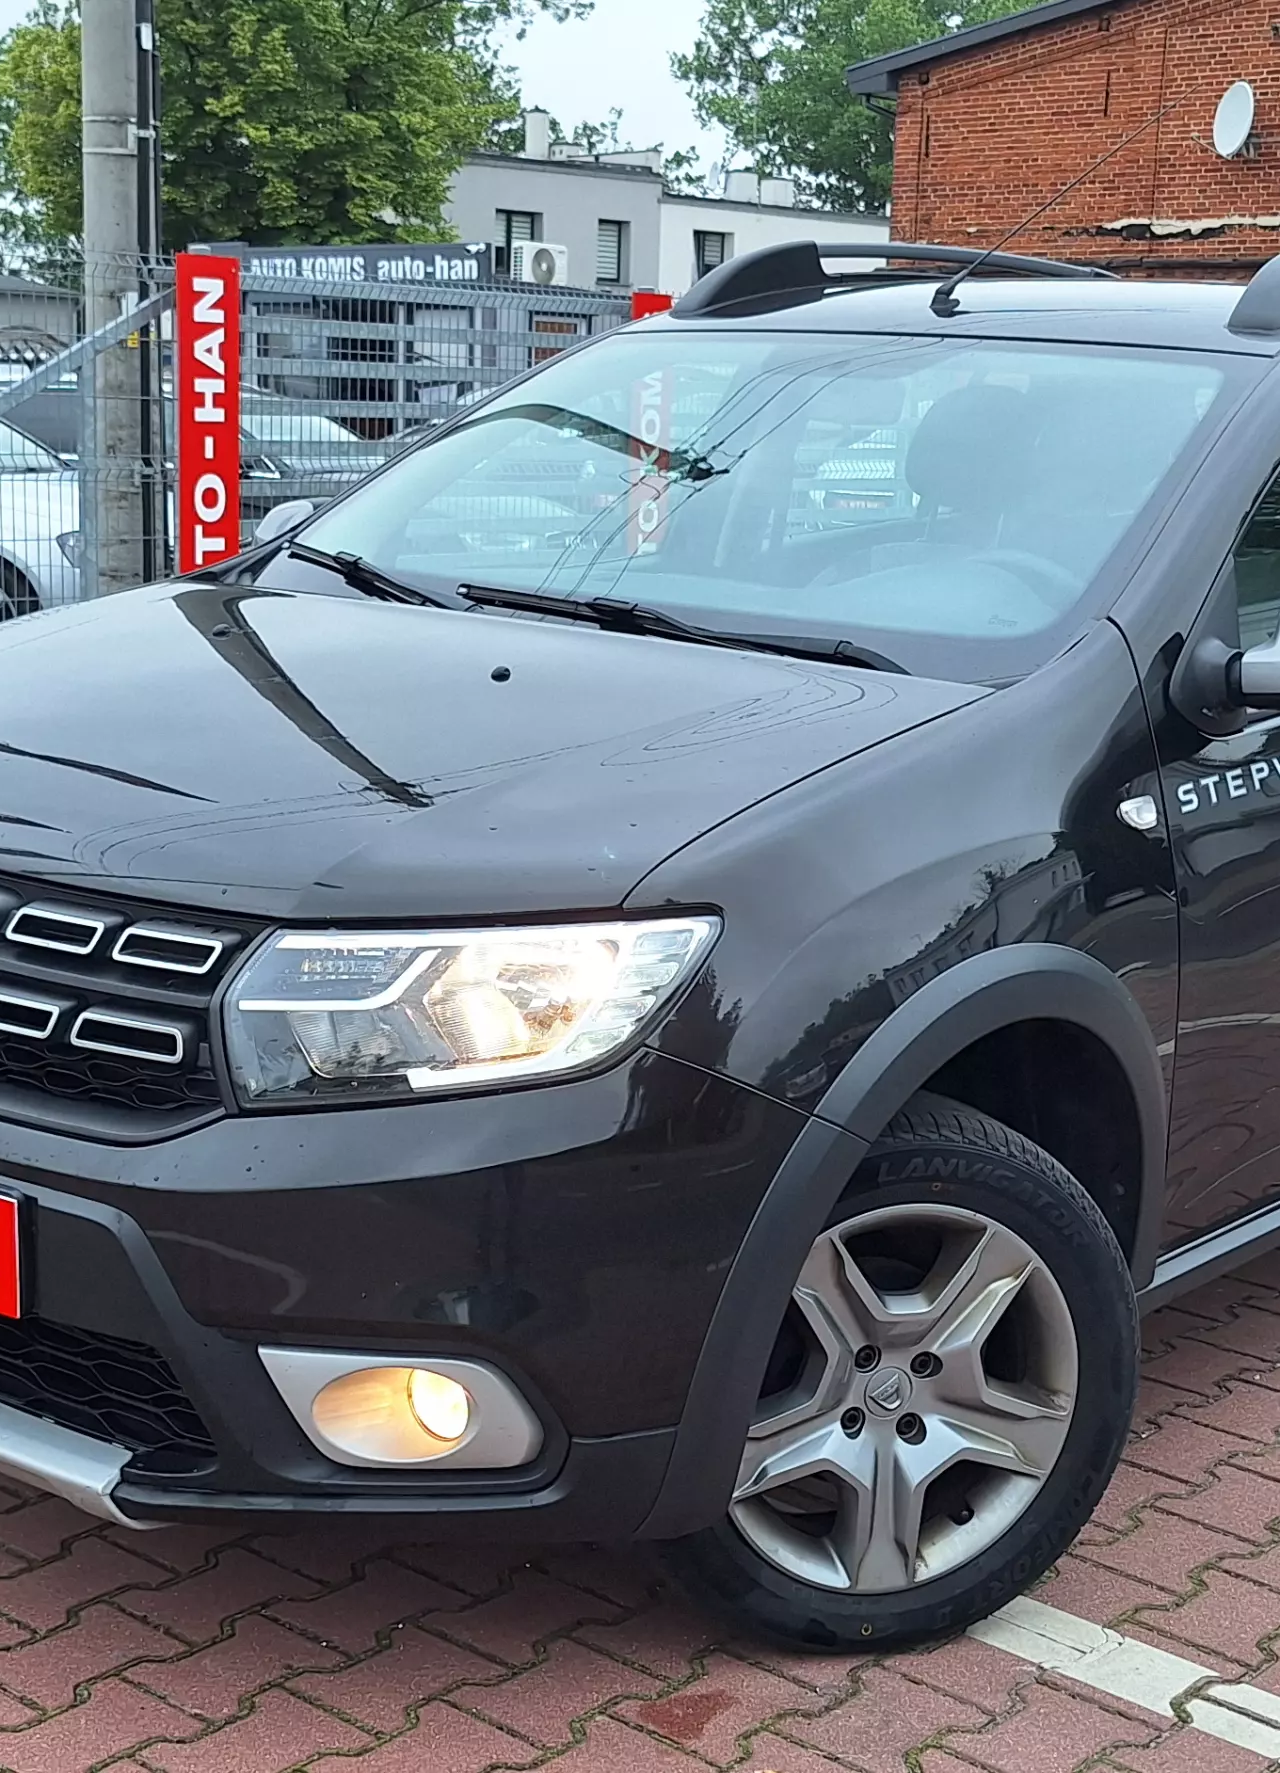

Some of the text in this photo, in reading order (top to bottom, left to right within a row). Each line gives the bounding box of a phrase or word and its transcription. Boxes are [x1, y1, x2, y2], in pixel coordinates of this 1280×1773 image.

[250, 254, 479, 281] AUTO KOMIS auto-han
[192, 276, 226, 565] TO-HAN
